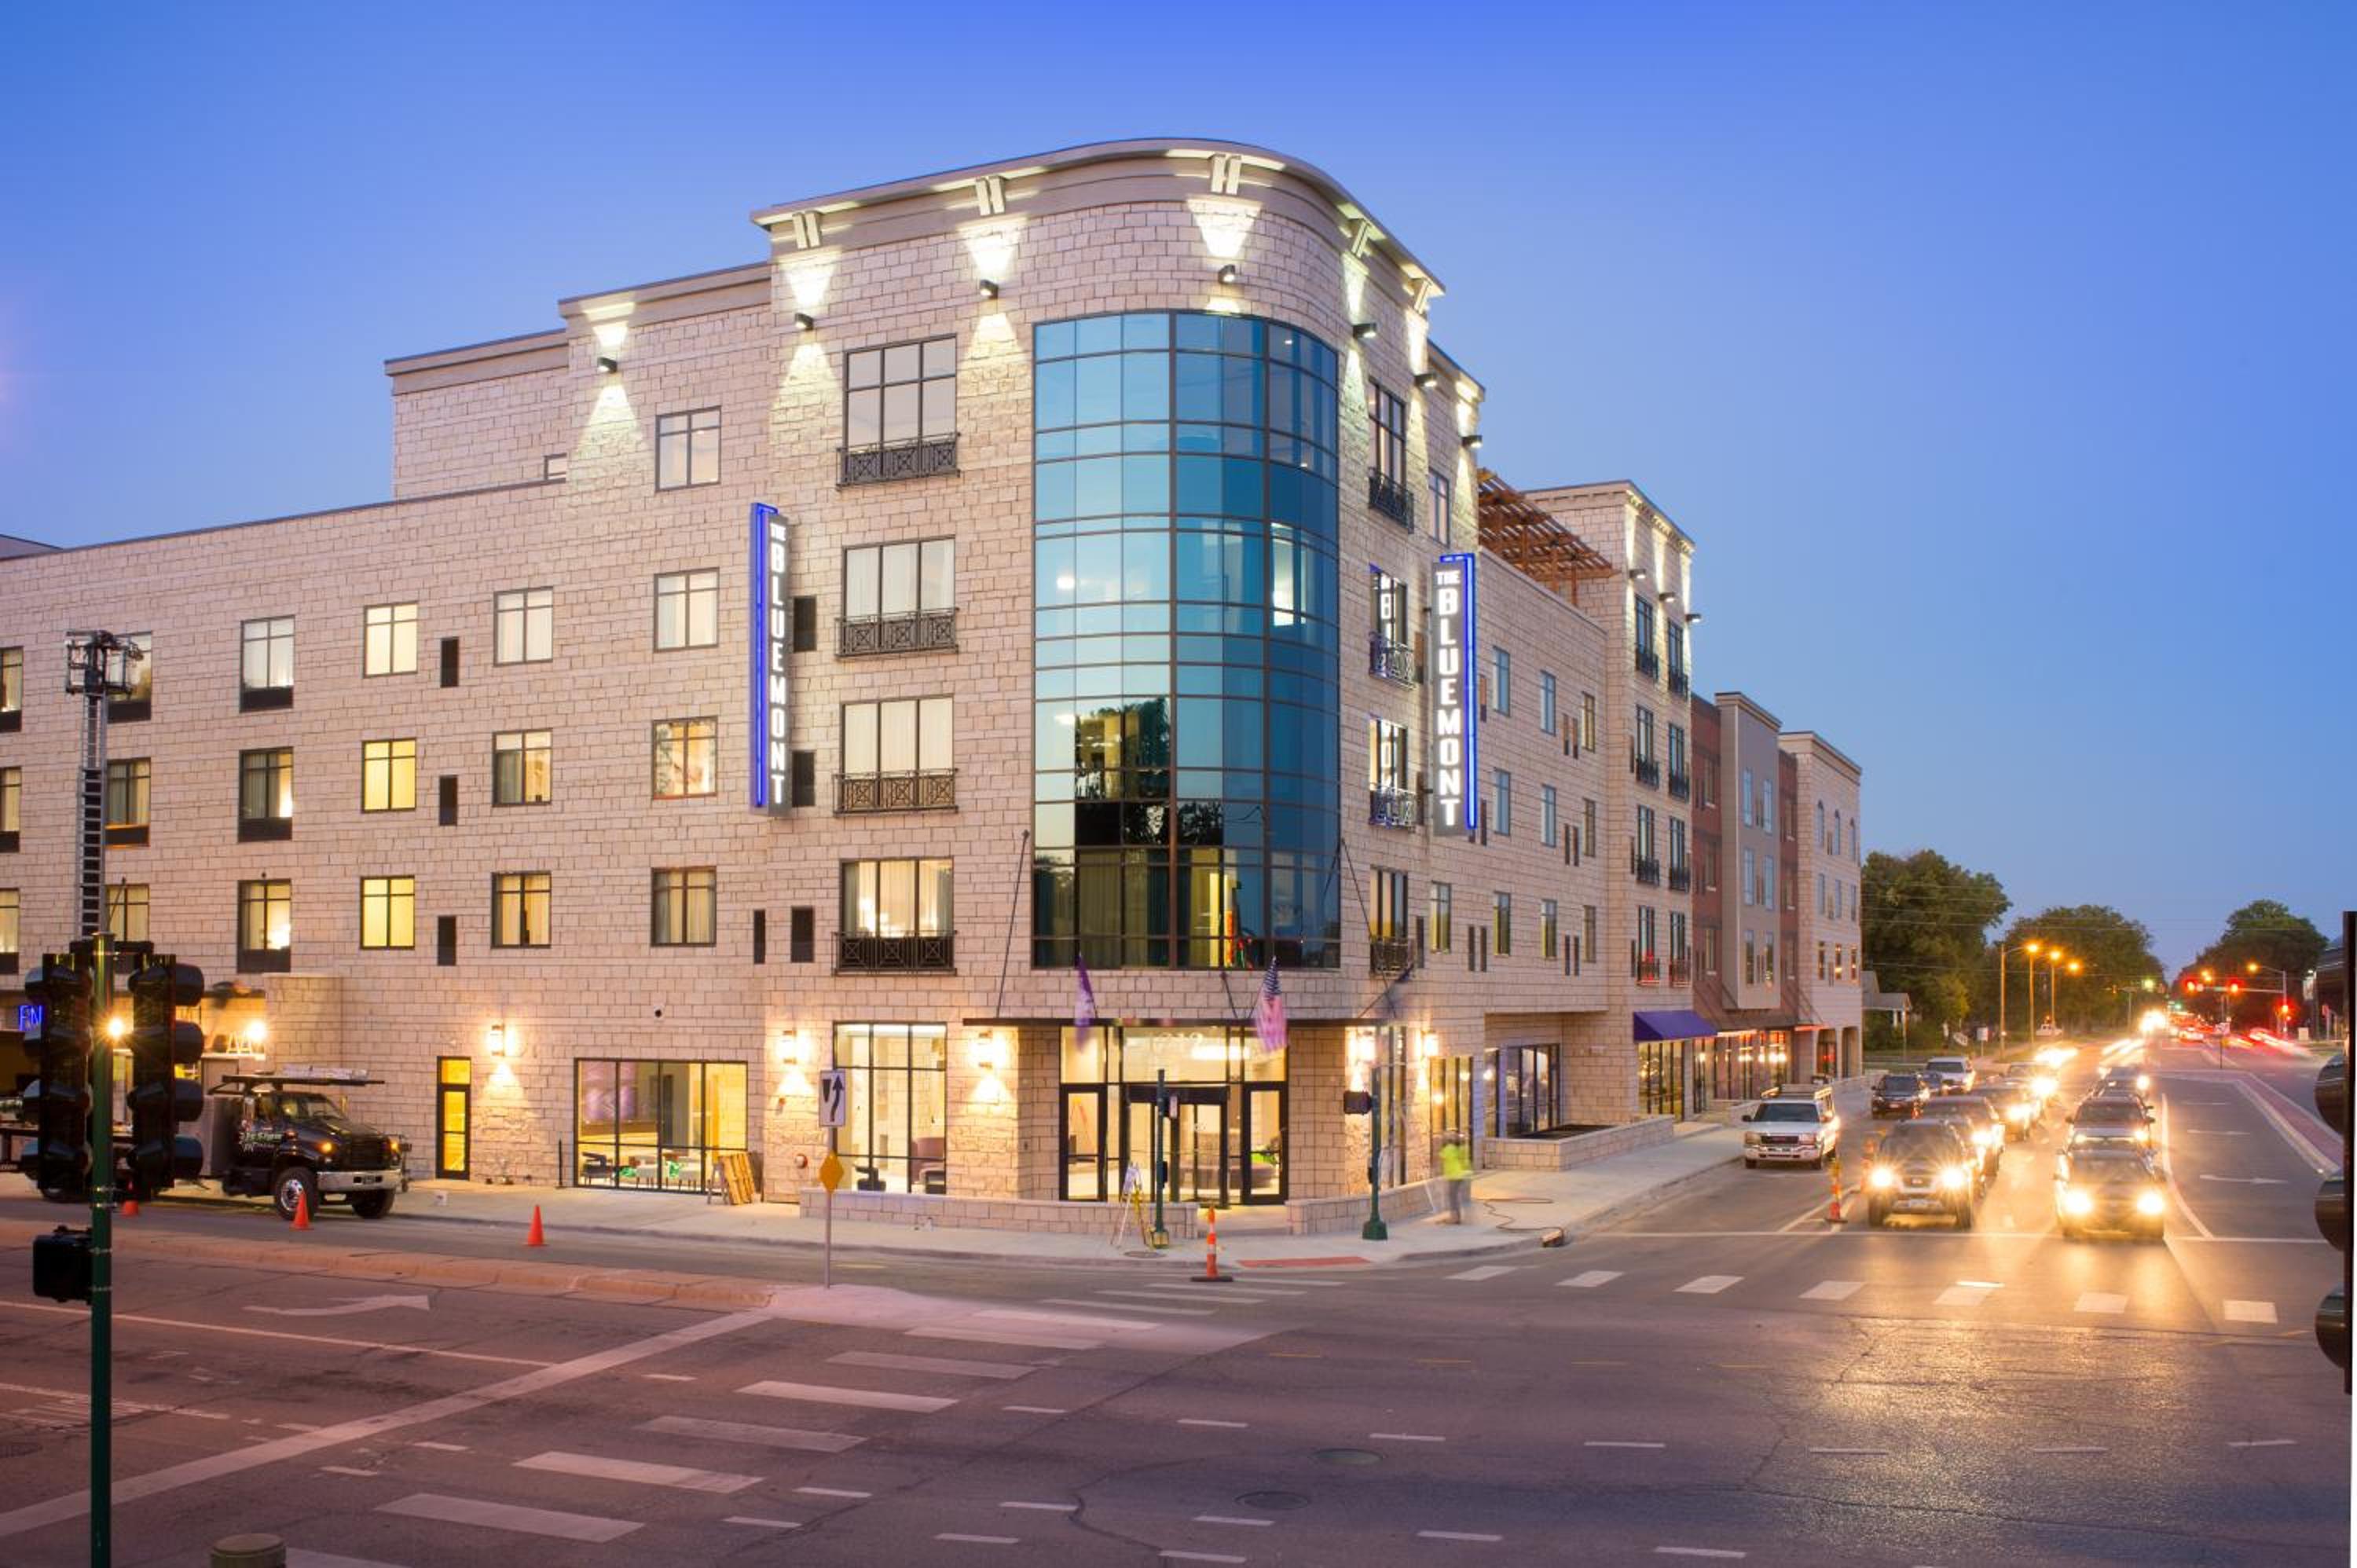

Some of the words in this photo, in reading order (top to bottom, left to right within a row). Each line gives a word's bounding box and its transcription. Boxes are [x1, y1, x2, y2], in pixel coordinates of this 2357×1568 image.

[770, 542, 786, 804] BLUEMONT
[1436, 570, 1461, 585] THE
[1437, 587, 1461, 826] BLUEMONT
